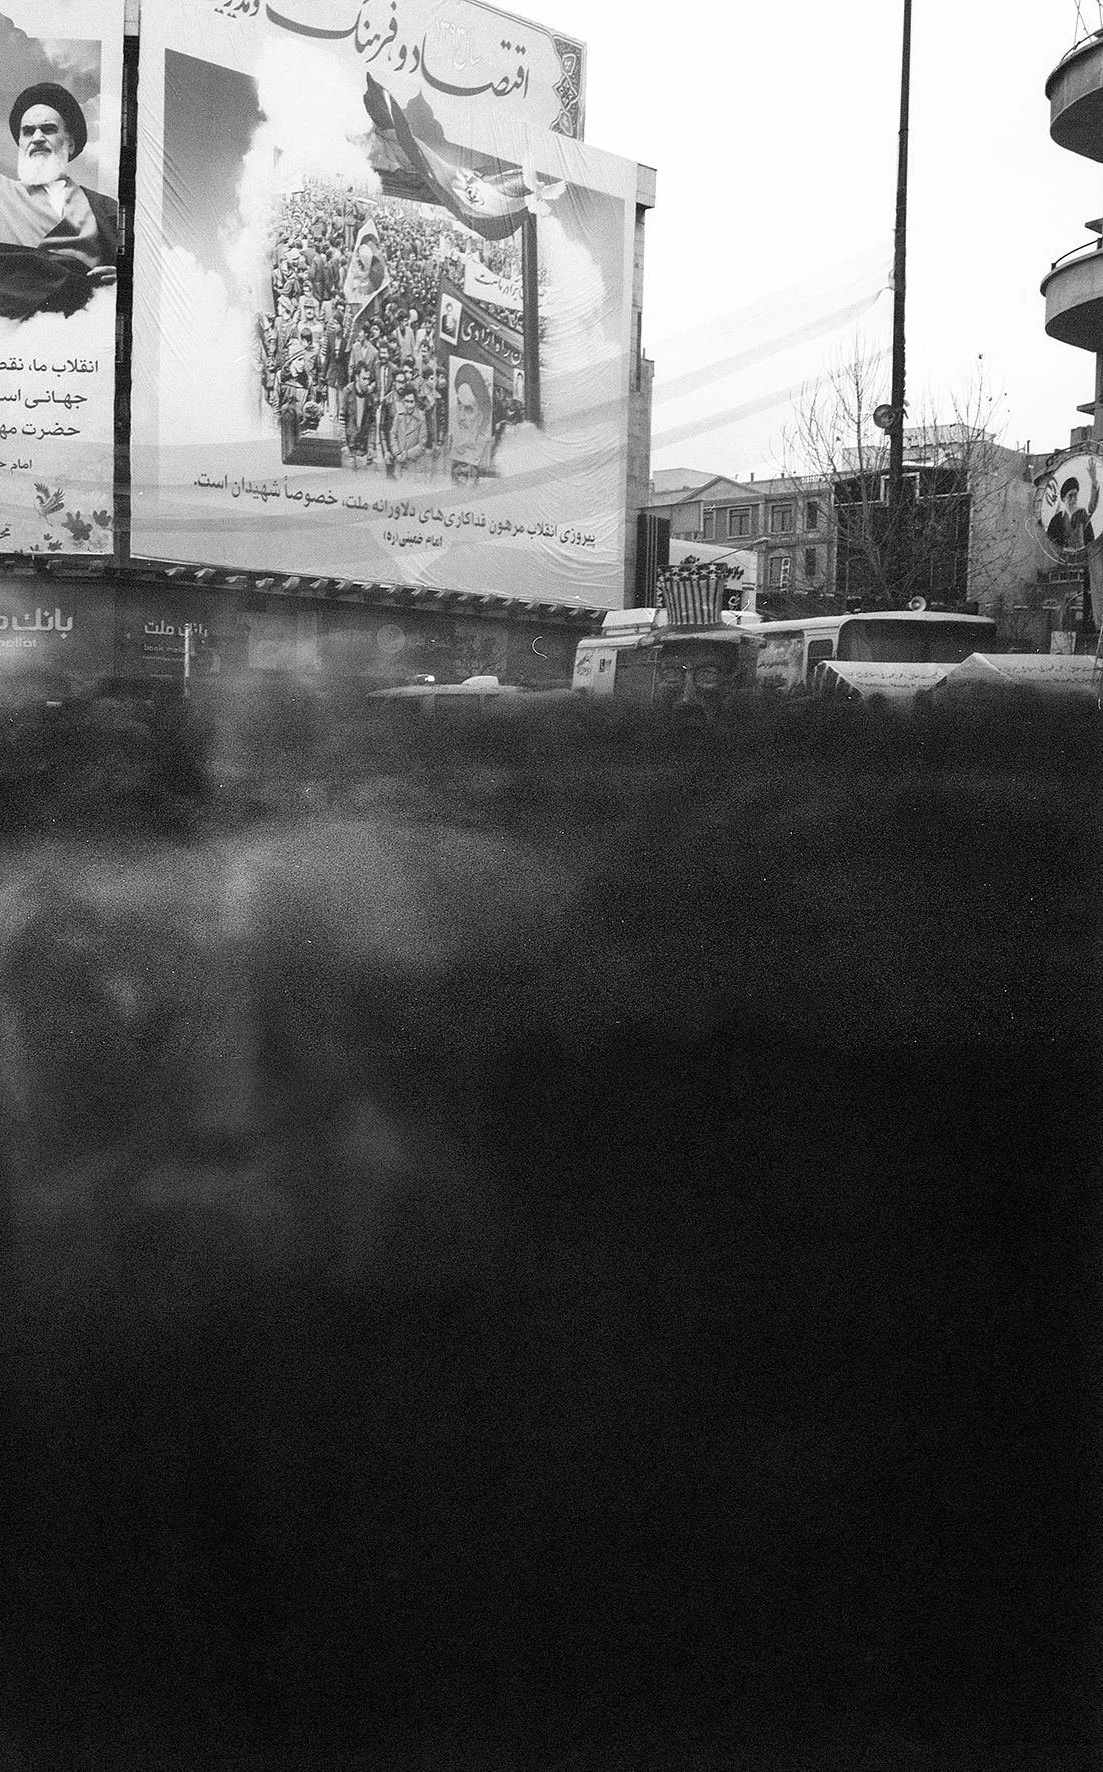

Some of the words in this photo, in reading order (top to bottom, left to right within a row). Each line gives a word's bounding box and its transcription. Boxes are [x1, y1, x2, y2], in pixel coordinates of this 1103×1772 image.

[409, 40, 529, 99] اقتصاد
[28, 358, 47, 374] ما،
[51, 357, 99, 378] انقلاب
[25, 389, 88, 410] جهانی
[21, 422, 81, 441] حضرت
[10, 458, 32, 471] امام
[231, 477, 281, 502] شهیدان
[372, 499, 416, 521] دلاورانه
[489, 520, 525, 536] مرهون
[527, 522, 558, 540] انقلاب
[560, 528, 596, 546] پیروزی
[399, 531, 423, 547] خمینی
[425, 533, 443, 548] امام
[12, 607, 73, 639] بانک
[144, 620, 175, 635] ملت
